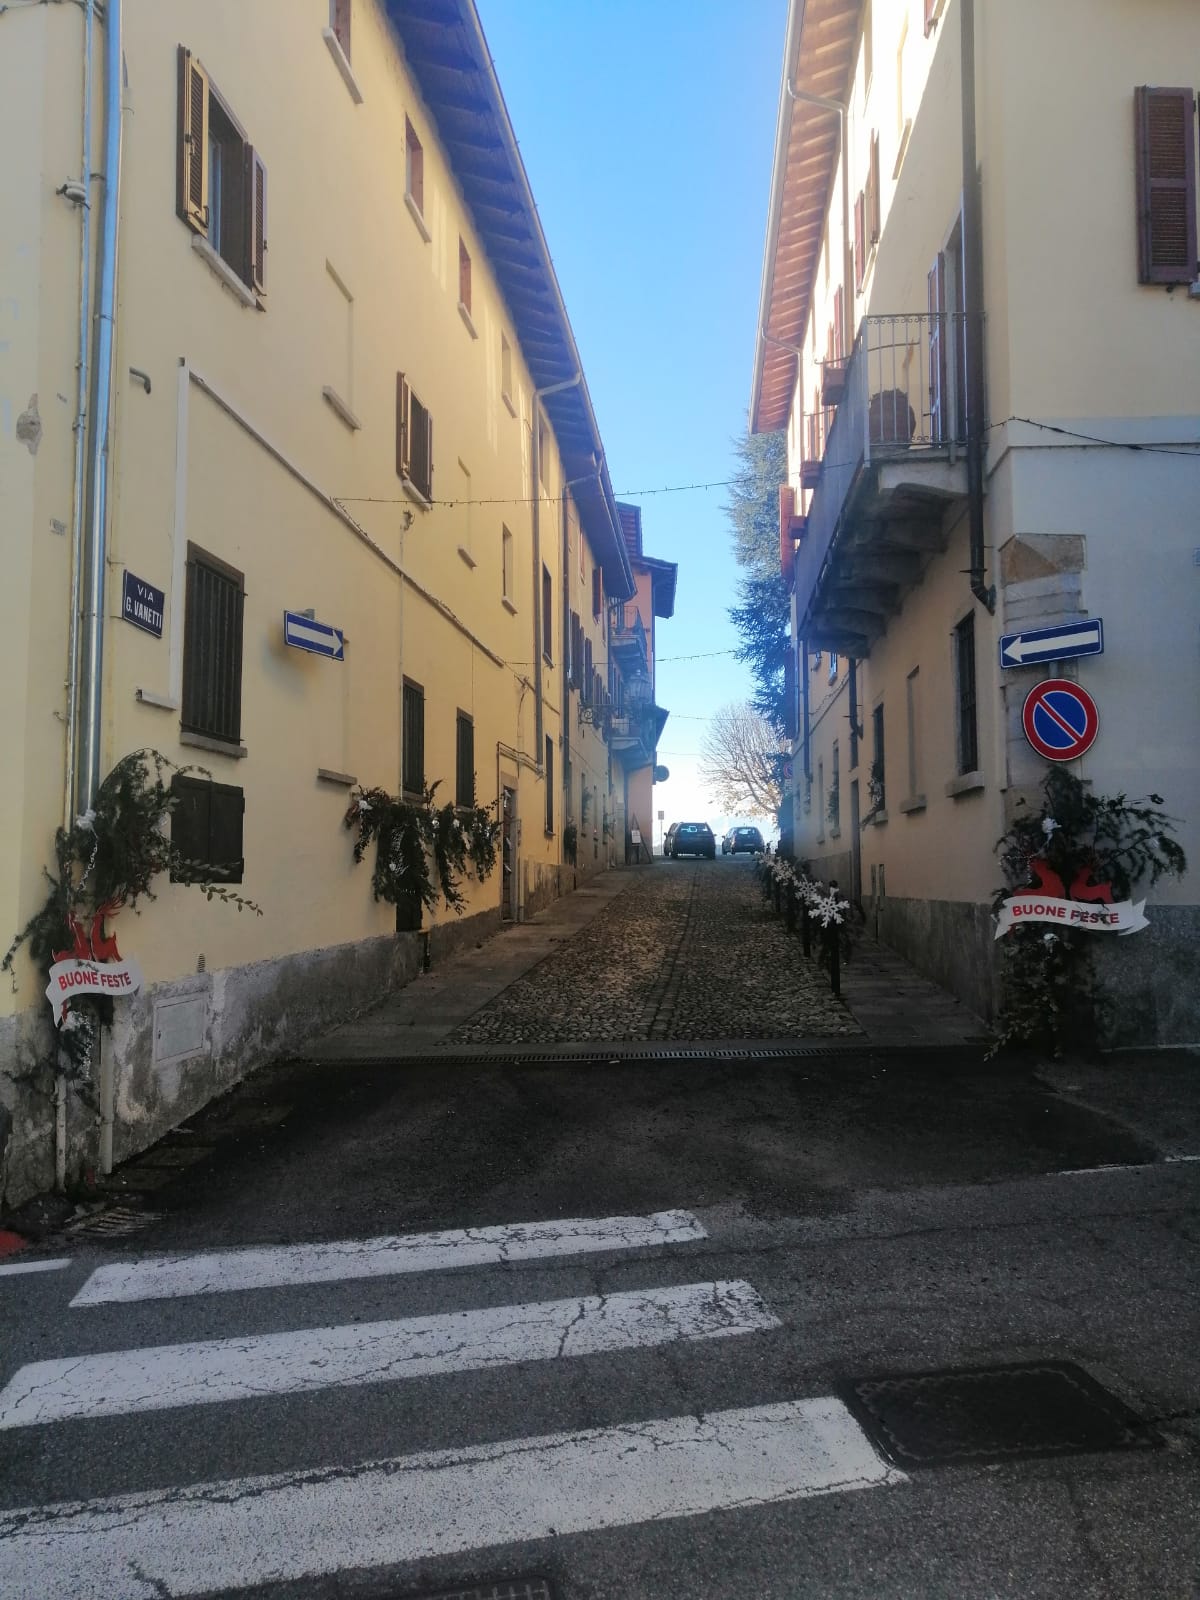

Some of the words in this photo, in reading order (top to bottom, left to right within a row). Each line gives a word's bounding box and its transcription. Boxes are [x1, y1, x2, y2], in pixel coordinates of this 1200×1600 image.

[137, 584, 154, 603] VIA
[126, 596, 133, 613] G.
[134, 600, 162, 629] VANETTI
[1012, 904, 1067, 918] BUONE
[1070, 909, 1120, 924] FESTE
[58, 971, 99, 991] BUONE
[100, 972, 132, 988] FESTE
